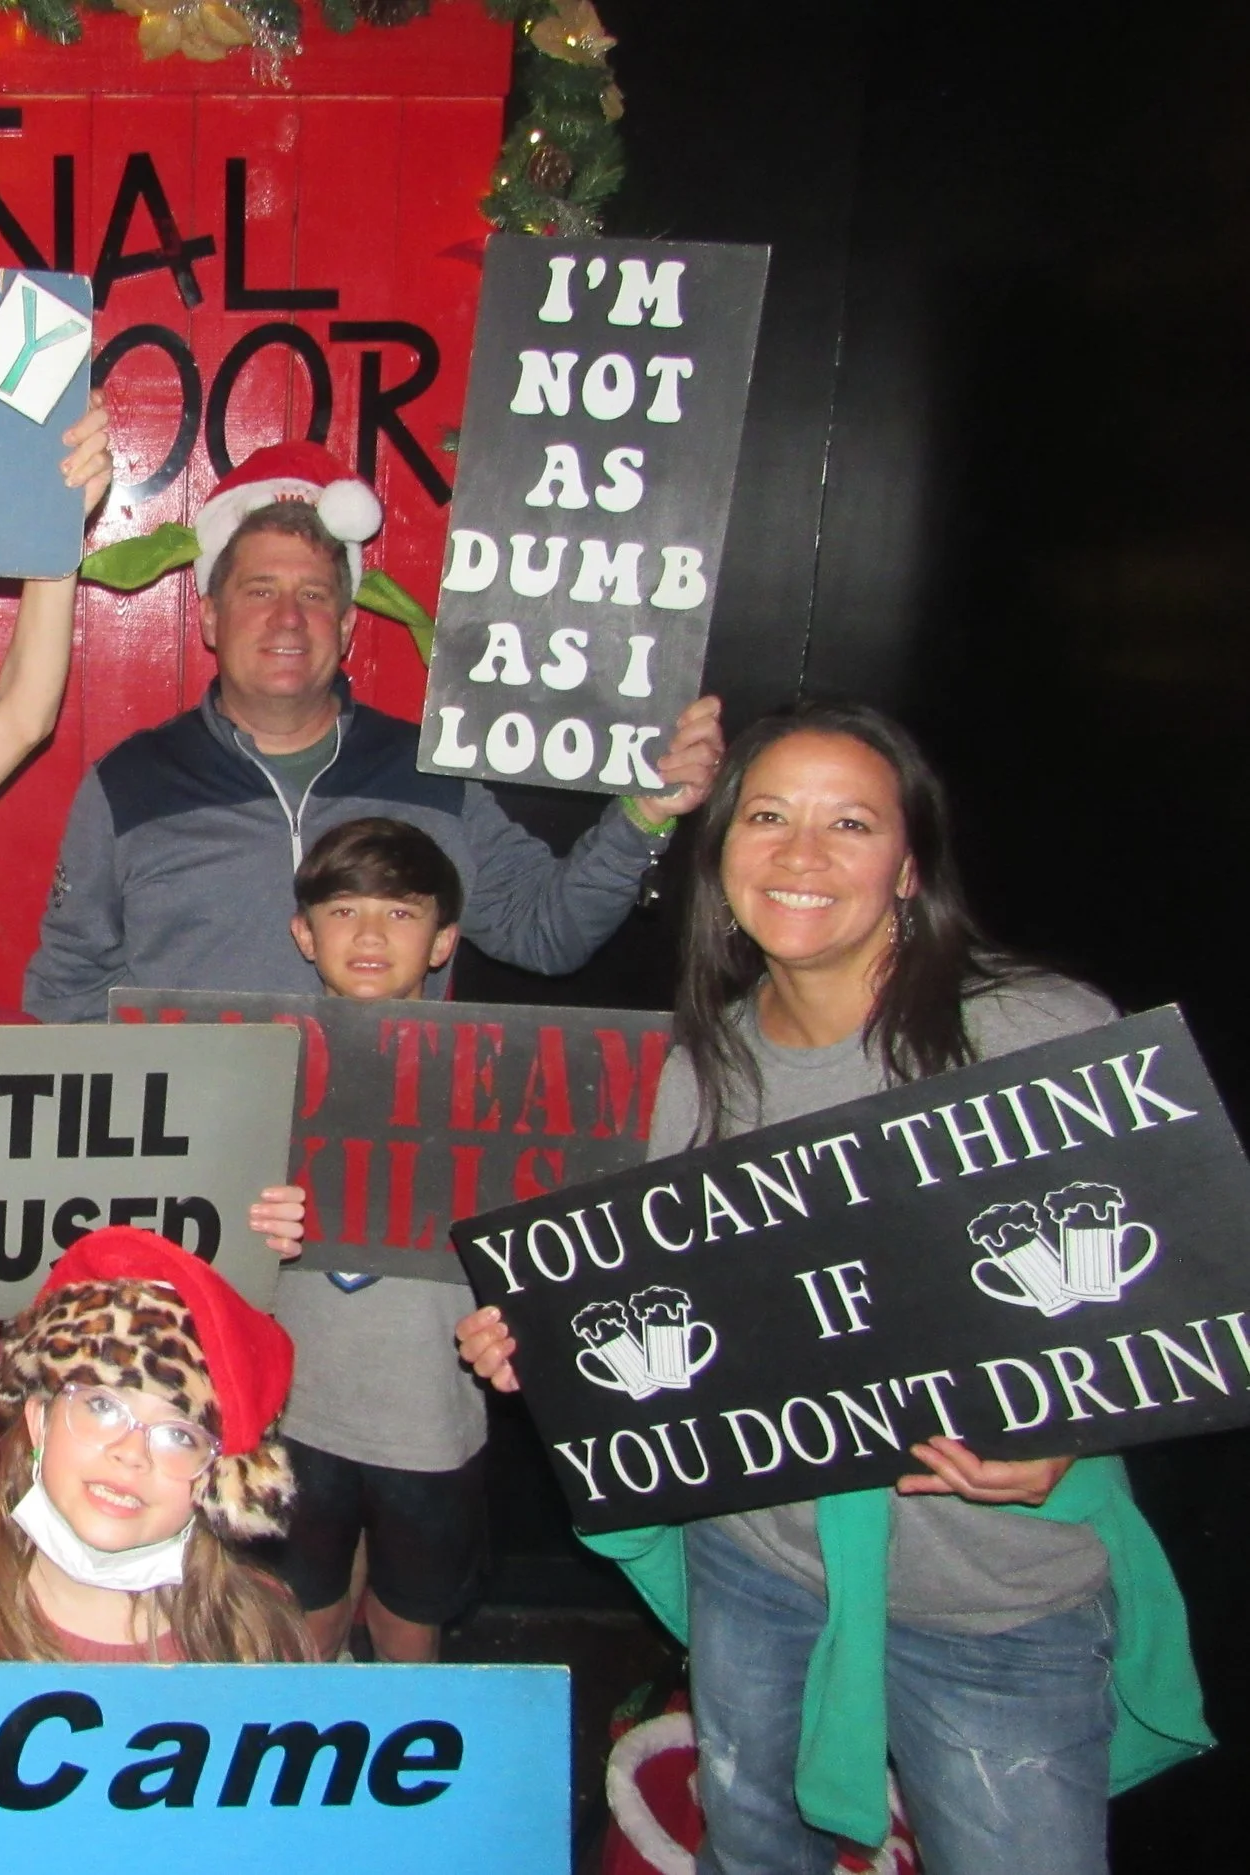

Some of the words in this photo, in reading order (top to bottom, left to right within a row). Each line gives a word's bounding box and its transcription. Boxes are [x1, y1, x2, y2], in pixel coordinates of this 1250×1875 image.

[538, 257, 686, 328] I'M
[91, 321, 454, 506] OOR
[510, 350, 693, 424] NOT
[525, 445, 645, 513] AS
[442, 529, 707, 610] DUMB
[468, 622, 589, 691] AS
[618, 635, 655, 698] I
[432, 706, 664, 789] LOOK
[379, 1018, 670, 1140] TEAM
[473, 1201, 625, 1294] YOU
[641, 1132, 871, 1252] CAN'T
[881, 1044, 1198, 1188] THINK
[794, 1259, 874, 1340] IF
[554, 1417, 712, 1503] YOU
[719, 1369, 964, 1477] DON'T
